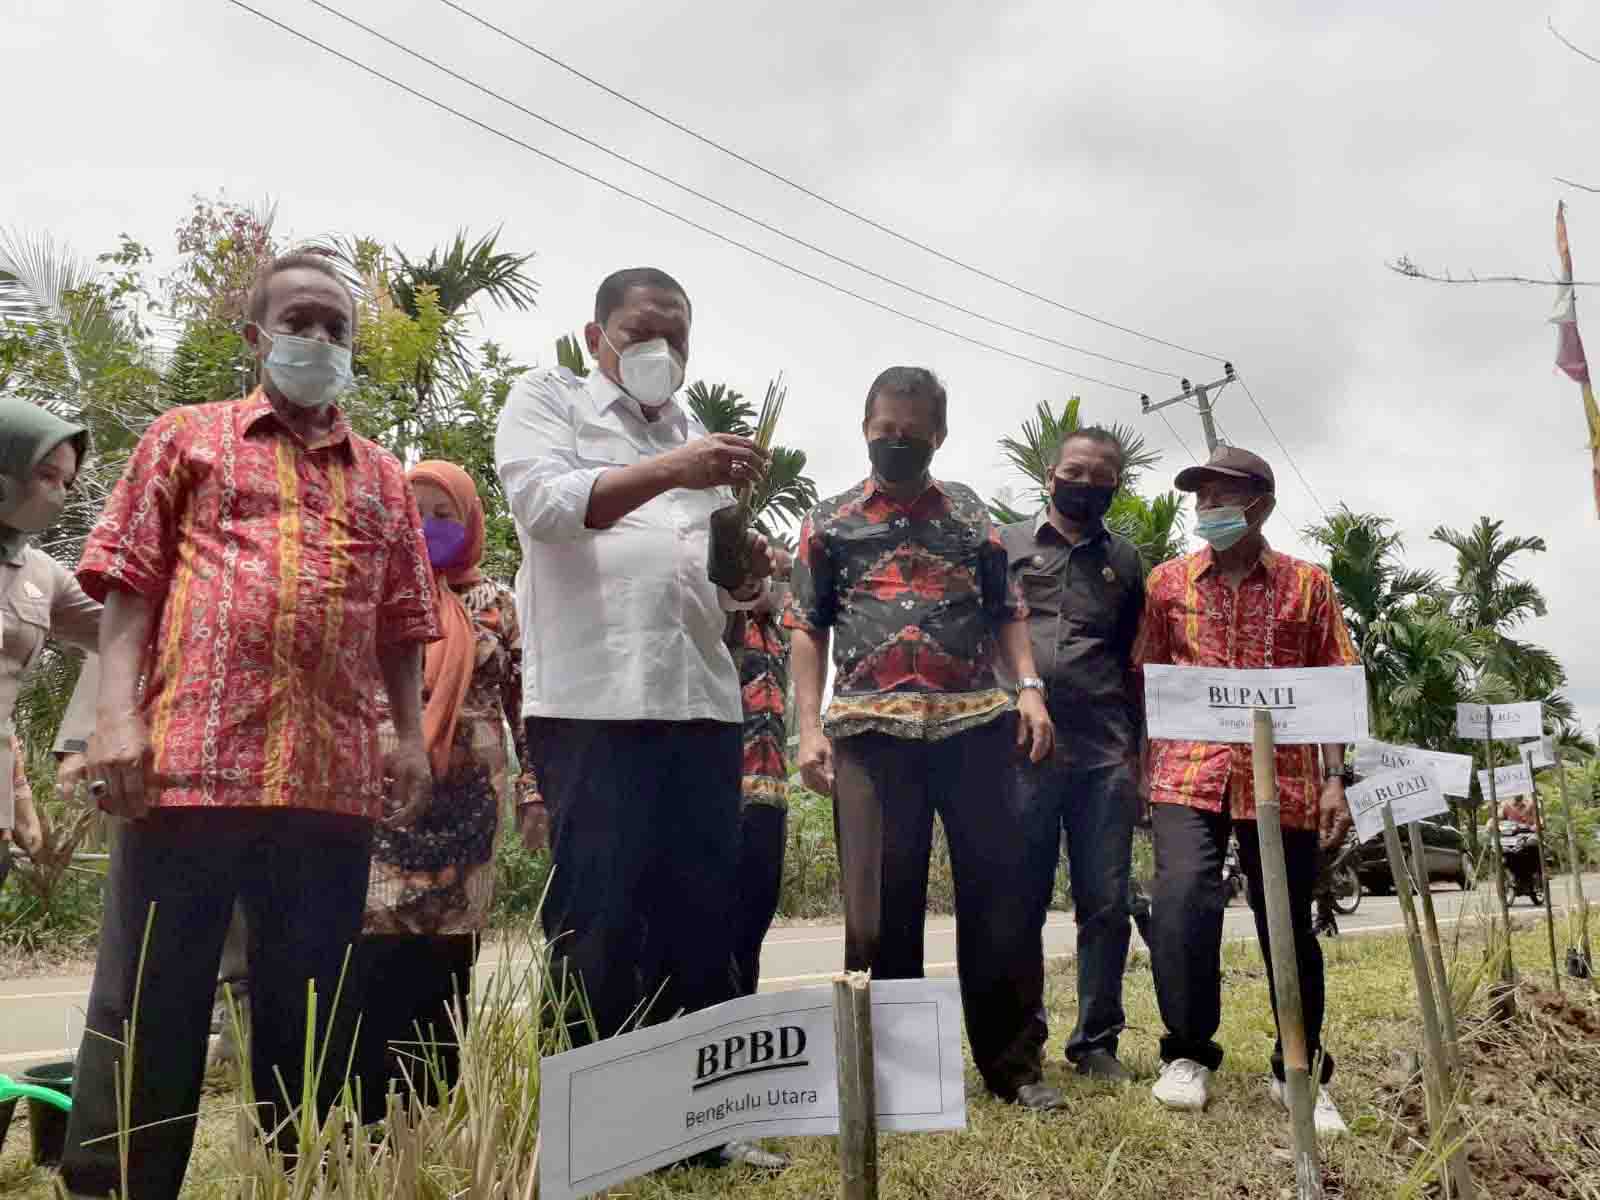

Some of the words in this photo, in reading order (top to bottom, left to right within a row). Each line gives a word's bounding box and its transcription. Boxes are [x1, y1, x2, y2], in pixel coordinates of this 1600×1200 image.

[1209, 686, 1297, 705] BUPATI
[1375, 775, 1428, 801] BUPATI
[696, 1026, 807, 1080] BPBD
[685, 1092, 762, 1129] Bengkulu
[767, 1088, 818, 1107] Utara
